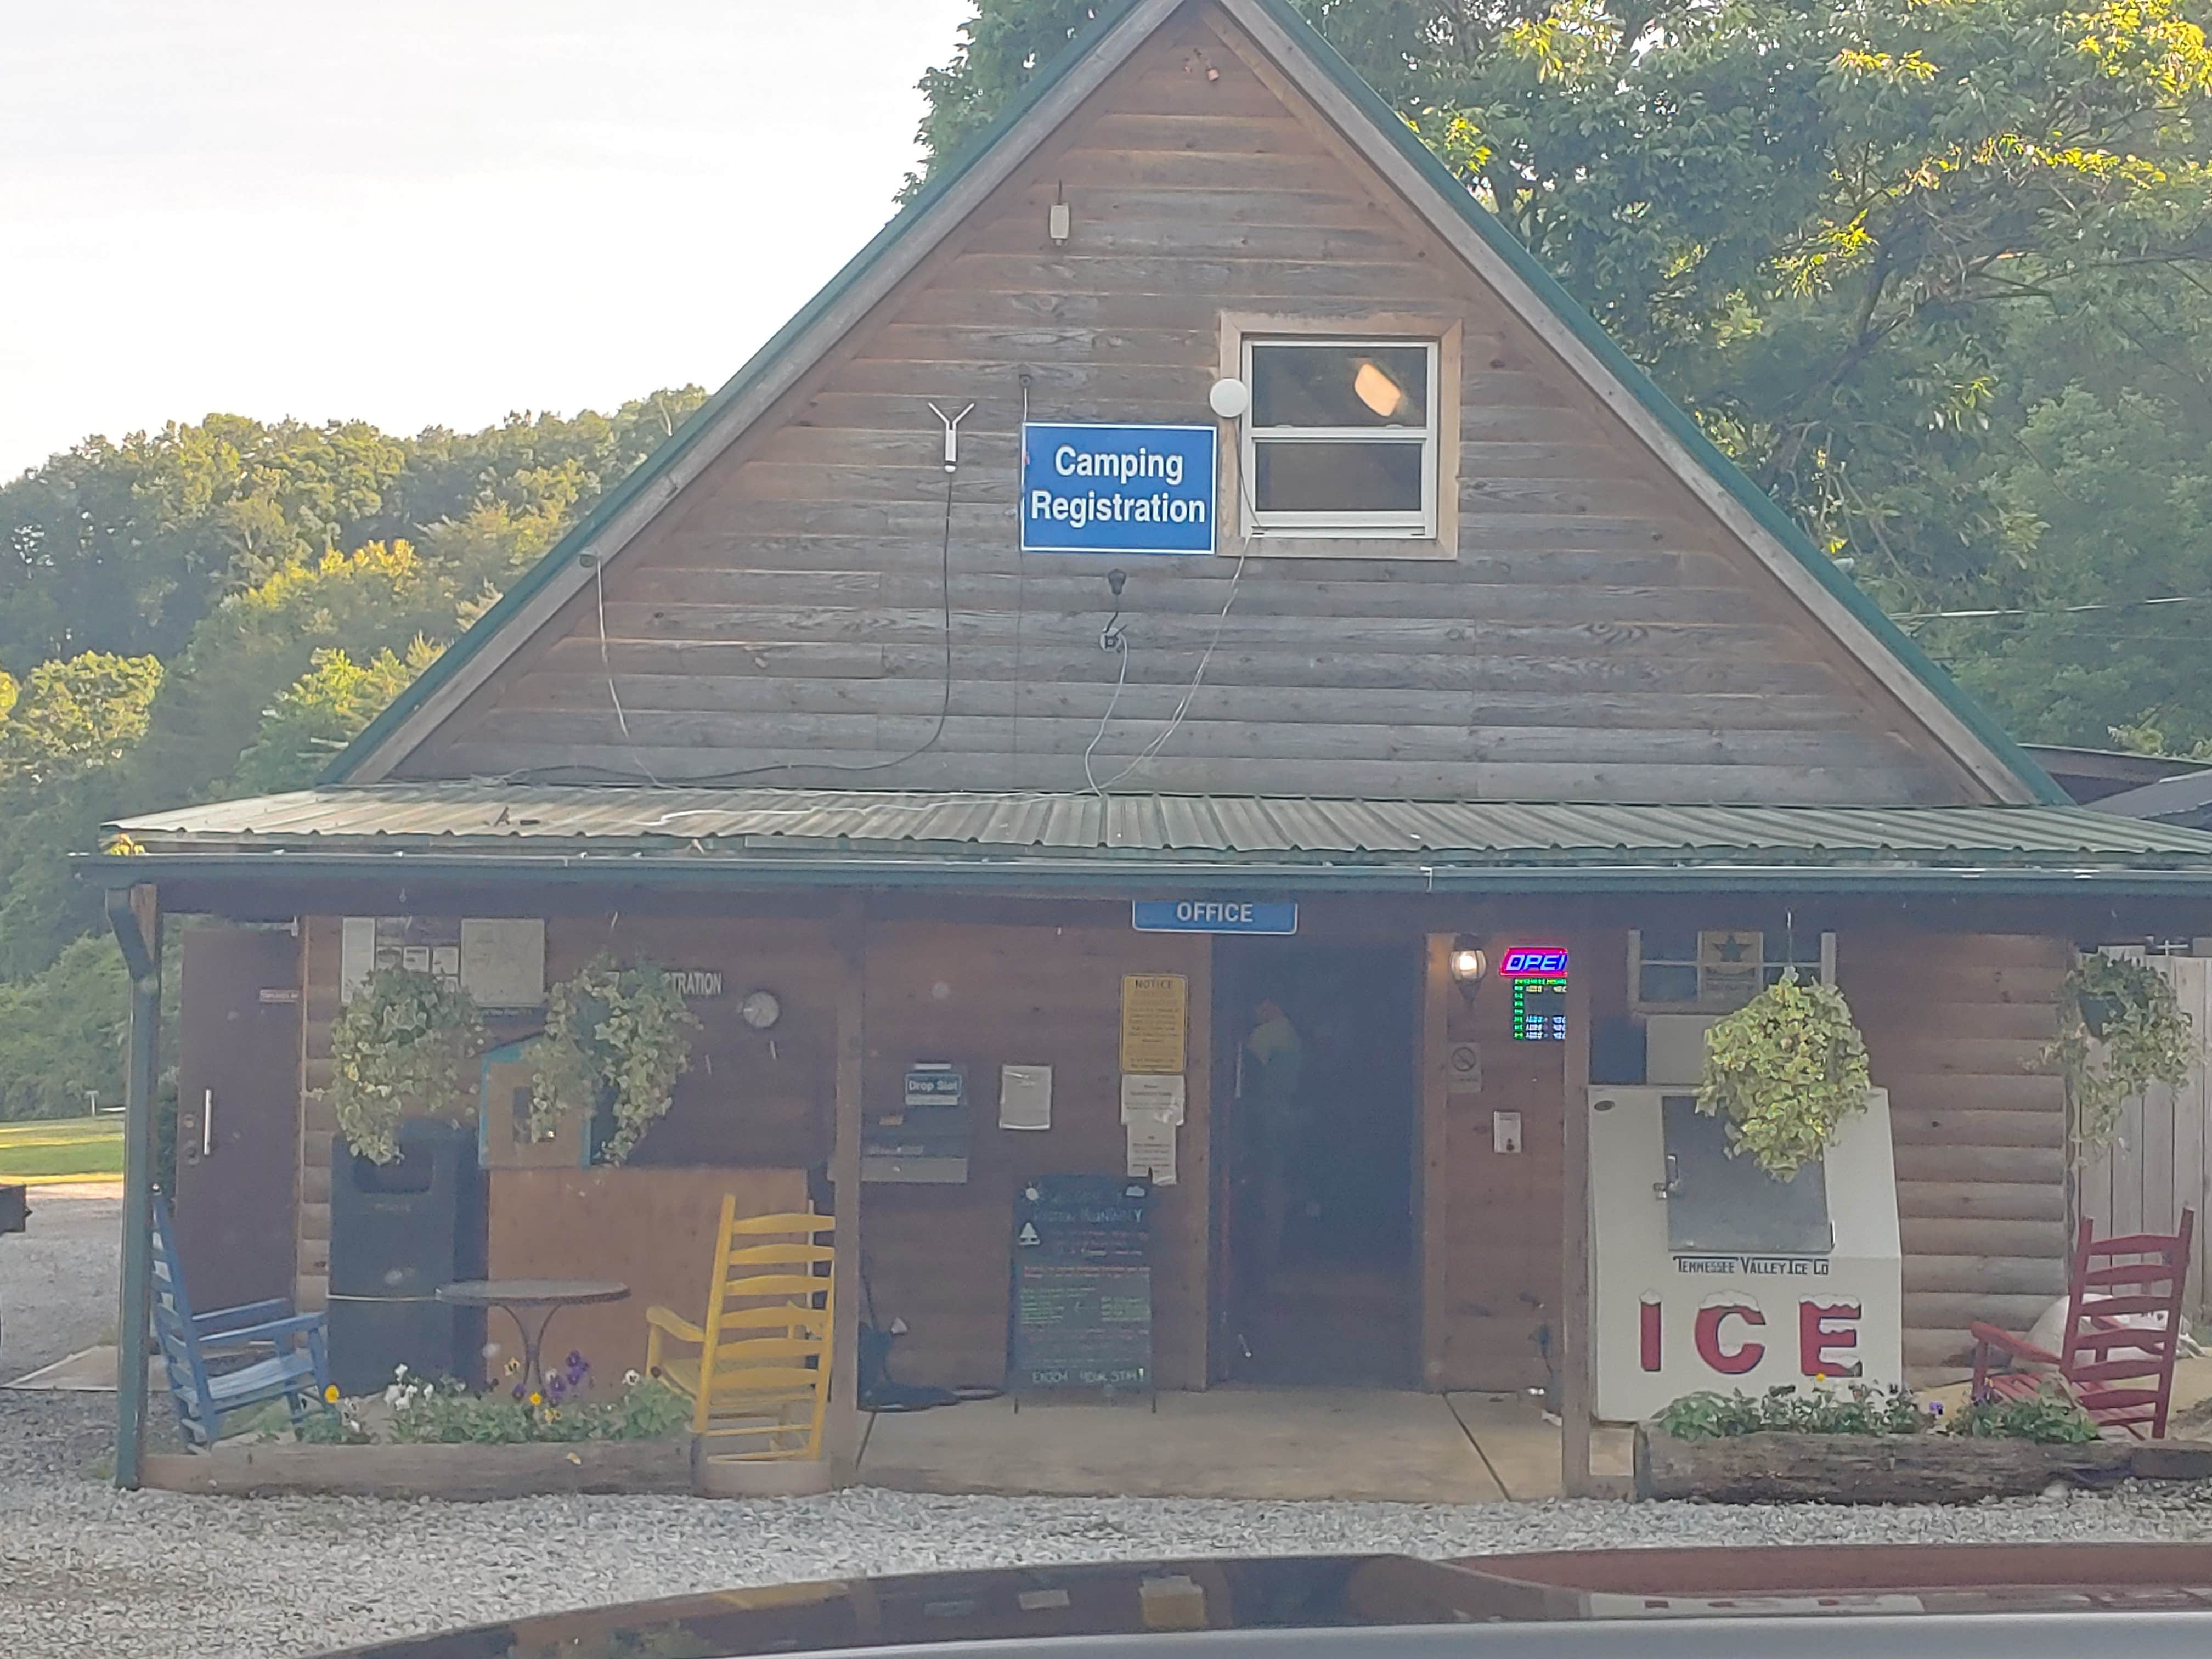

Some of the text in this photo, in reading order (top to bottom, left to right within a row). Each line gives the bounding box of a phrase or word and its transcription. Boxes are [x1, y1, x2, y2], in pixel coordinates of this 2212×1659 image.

[1055, 445, 1183, 486] Camping
[1031, 490, 1206, 528] Registration
[1176, 902, 1253, 922] OFFICE
[671, 972, 722, 994] TRATION
[1135, 979, 1173, 989] NOTICE
[909, 1080, 934, 1092] Drop
[1673, 1256, 1738, 1273] TENNESSEE
[1740, 1257, 1786, 1274] VALLEY
[1786, 1259, 1810, 1274] ICE
[1639, 1290, 1863, 1377] ICE
